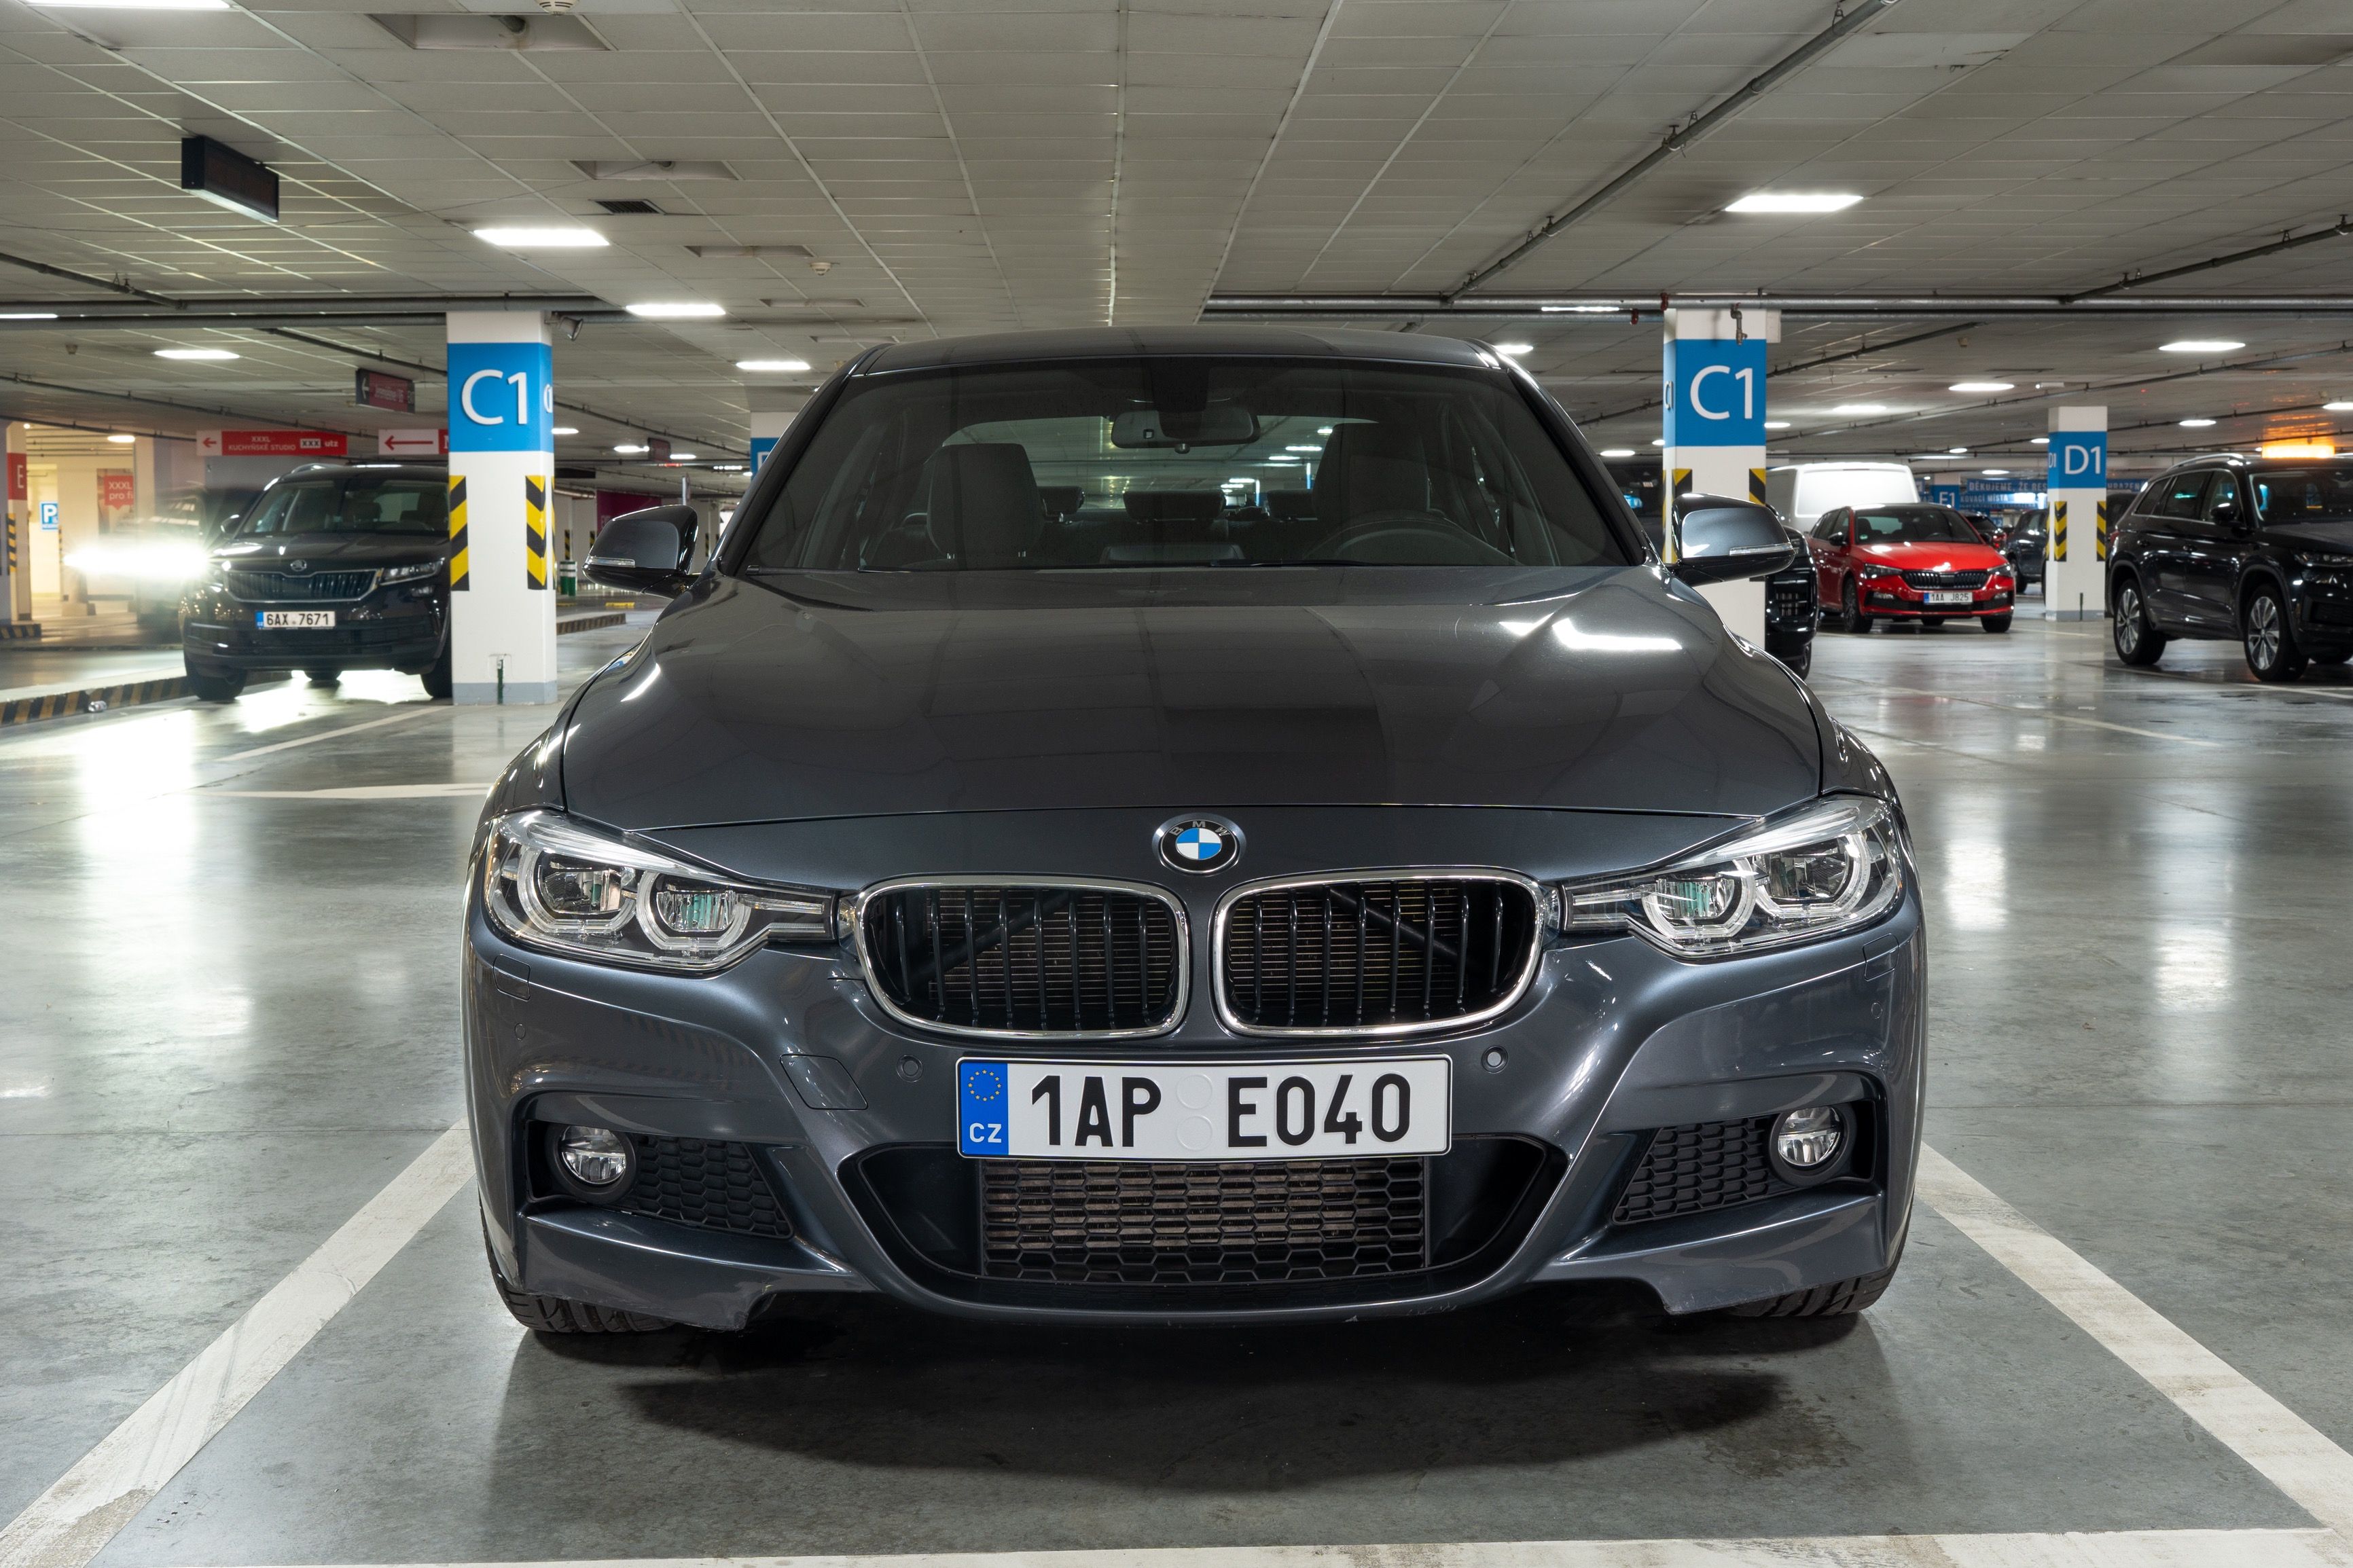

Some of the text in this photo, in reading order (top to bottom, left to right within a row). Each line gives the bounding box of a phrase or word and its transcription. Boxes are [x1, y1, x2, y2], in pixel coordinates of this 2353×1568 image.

[461, 369, 528, 425] C1
[1690, 365, 1753, 420] C1
[2065, 445, 2100, 474] D1
[109, 493, 125, 501] pro
[266, 613, 329, 625] 6AX 7671
[1168, 820, 1231, 836] BMW
[1032, 1074, 1162, 1148] 1AP
[969, 1123, 1002, 1144] CZ
